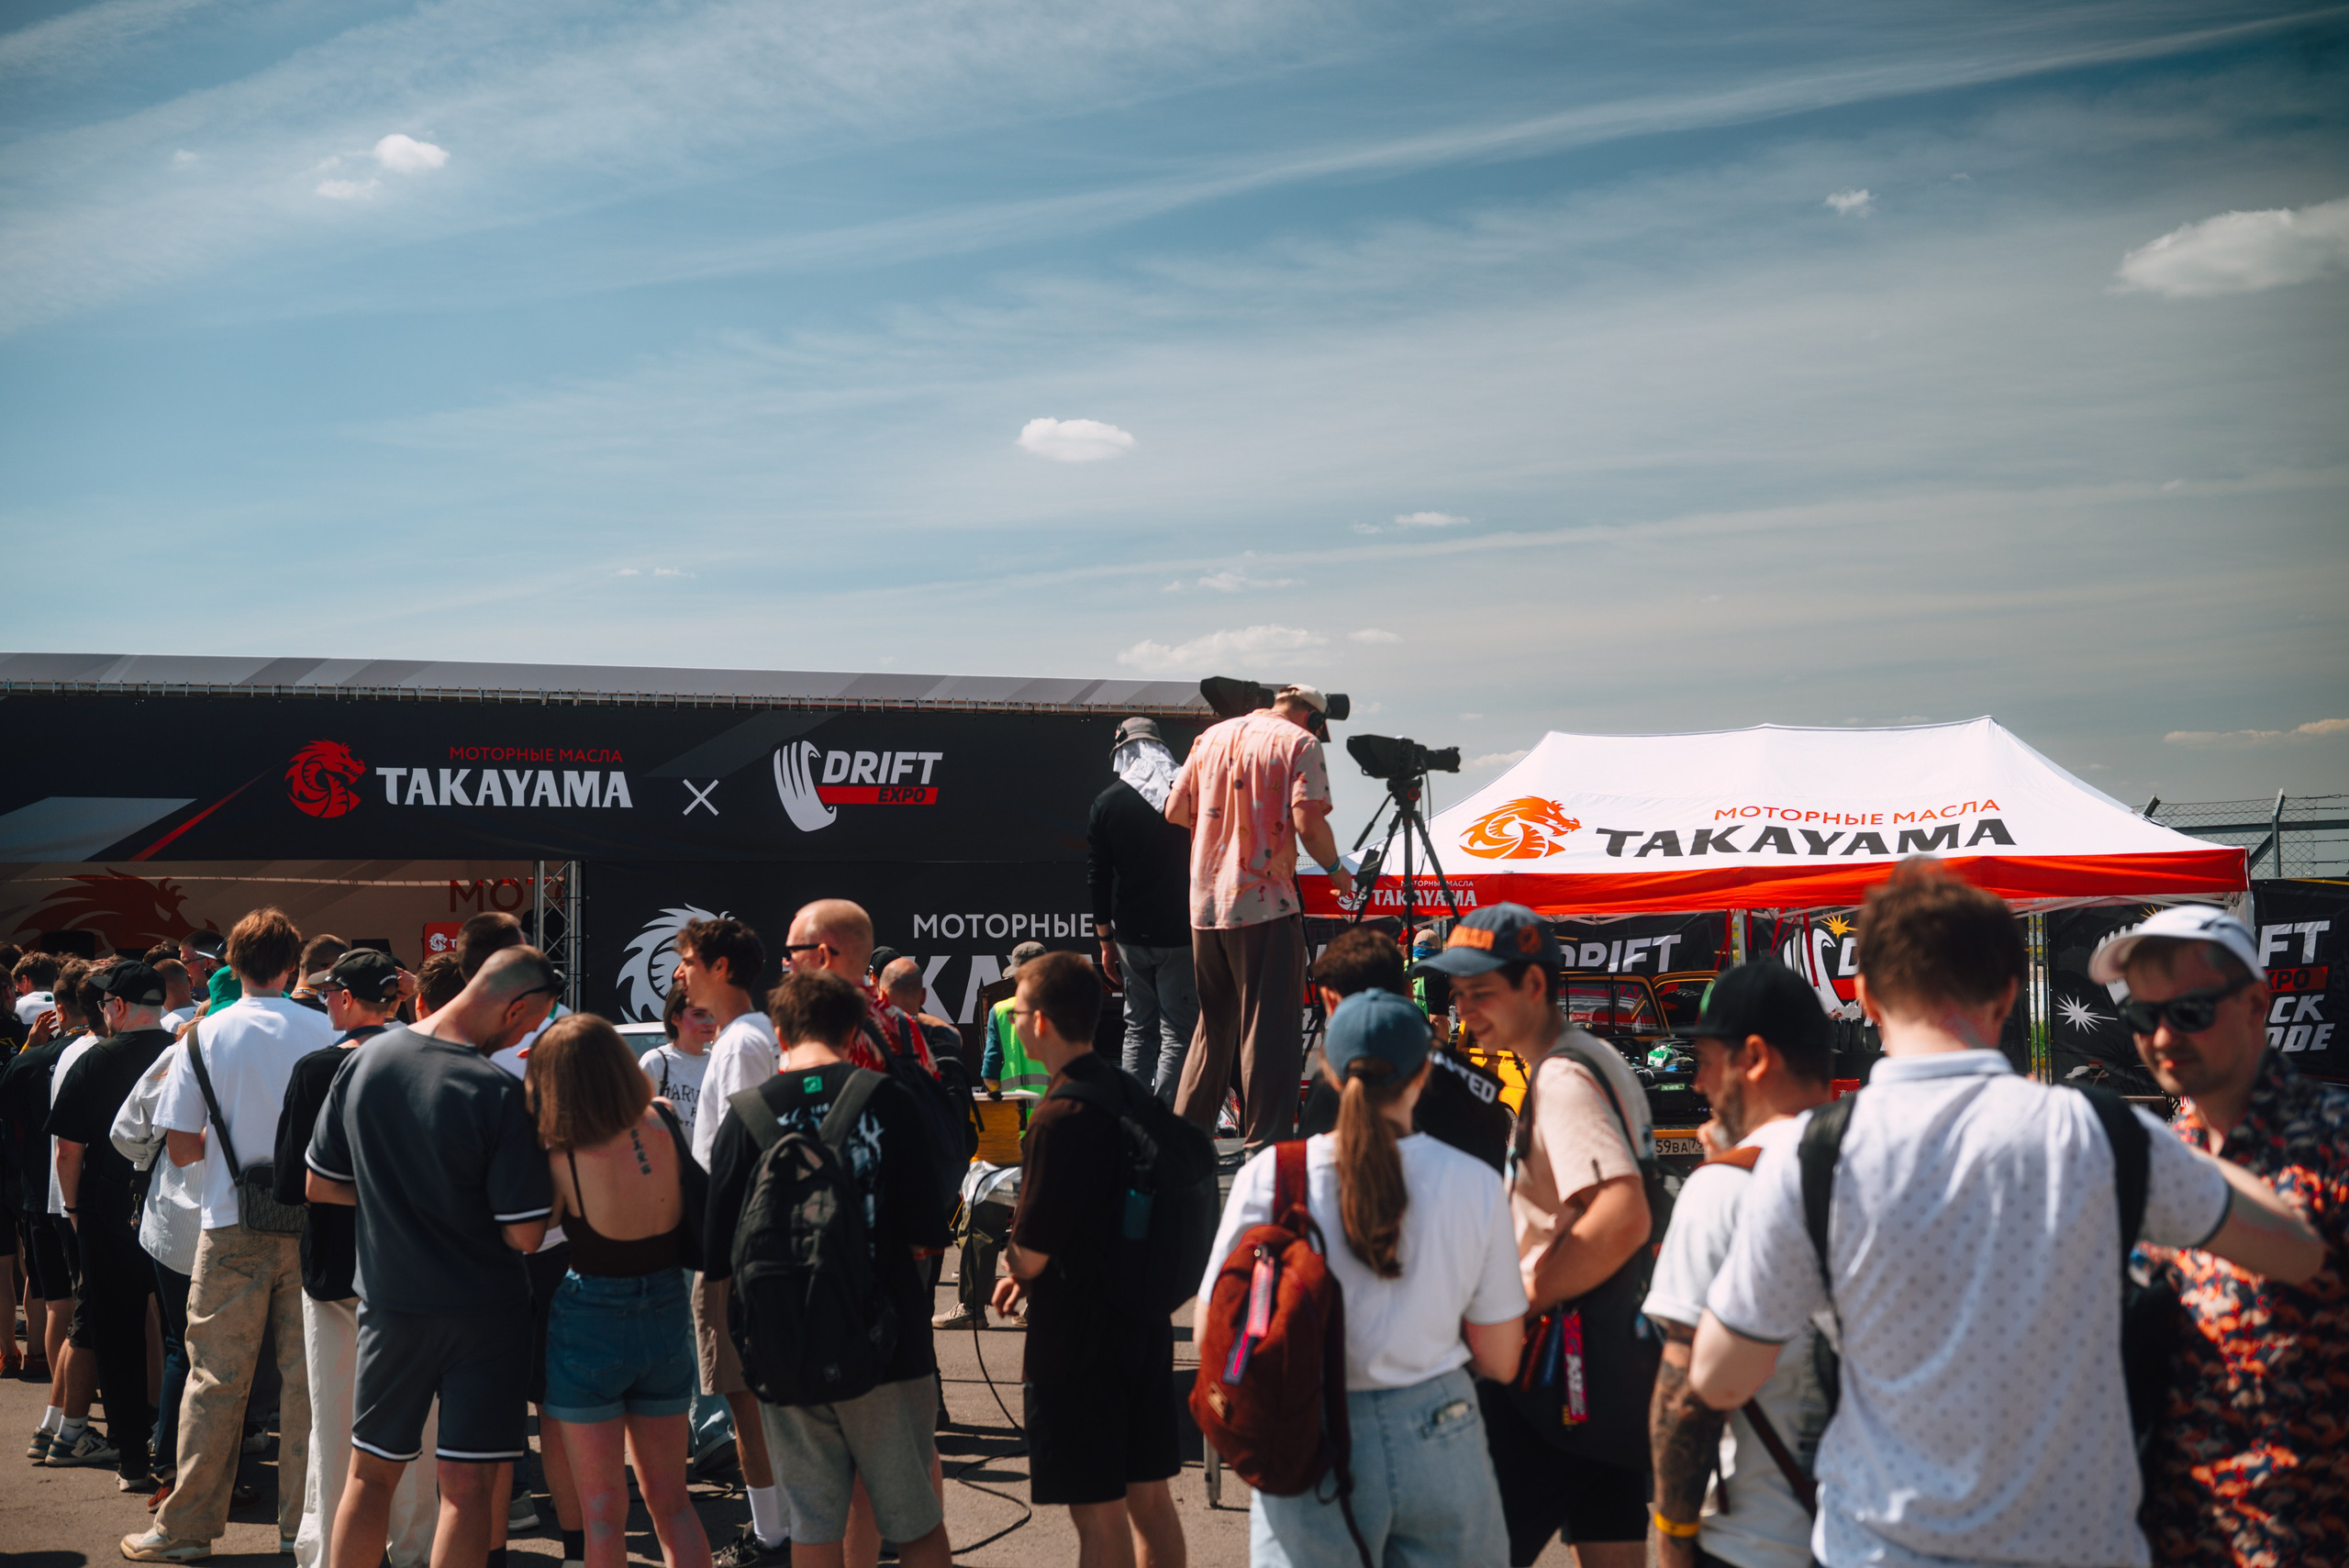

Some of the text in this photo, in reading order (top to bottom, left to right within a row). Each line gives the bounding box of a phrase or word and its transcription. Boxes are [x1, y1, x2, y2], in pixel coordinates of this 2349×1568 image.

[450, 746, 623, 762] МОТОРНЫЕ МАСЛА
[821, 750, 944, 784] DRIFT
[375, 767, 634, 808] TAKAYAMA
[877, 787, 927, 803] EXPO
[1714, 798, 2001, 826] МОТОРНЫЕ МАСЛА
[1595, 817, 2018, 858] TAKAYAMA
[1372, 889, 1478, 907] TAKAYAMA
[913, 913, 1095, 940] МОТОРНЫЕ
